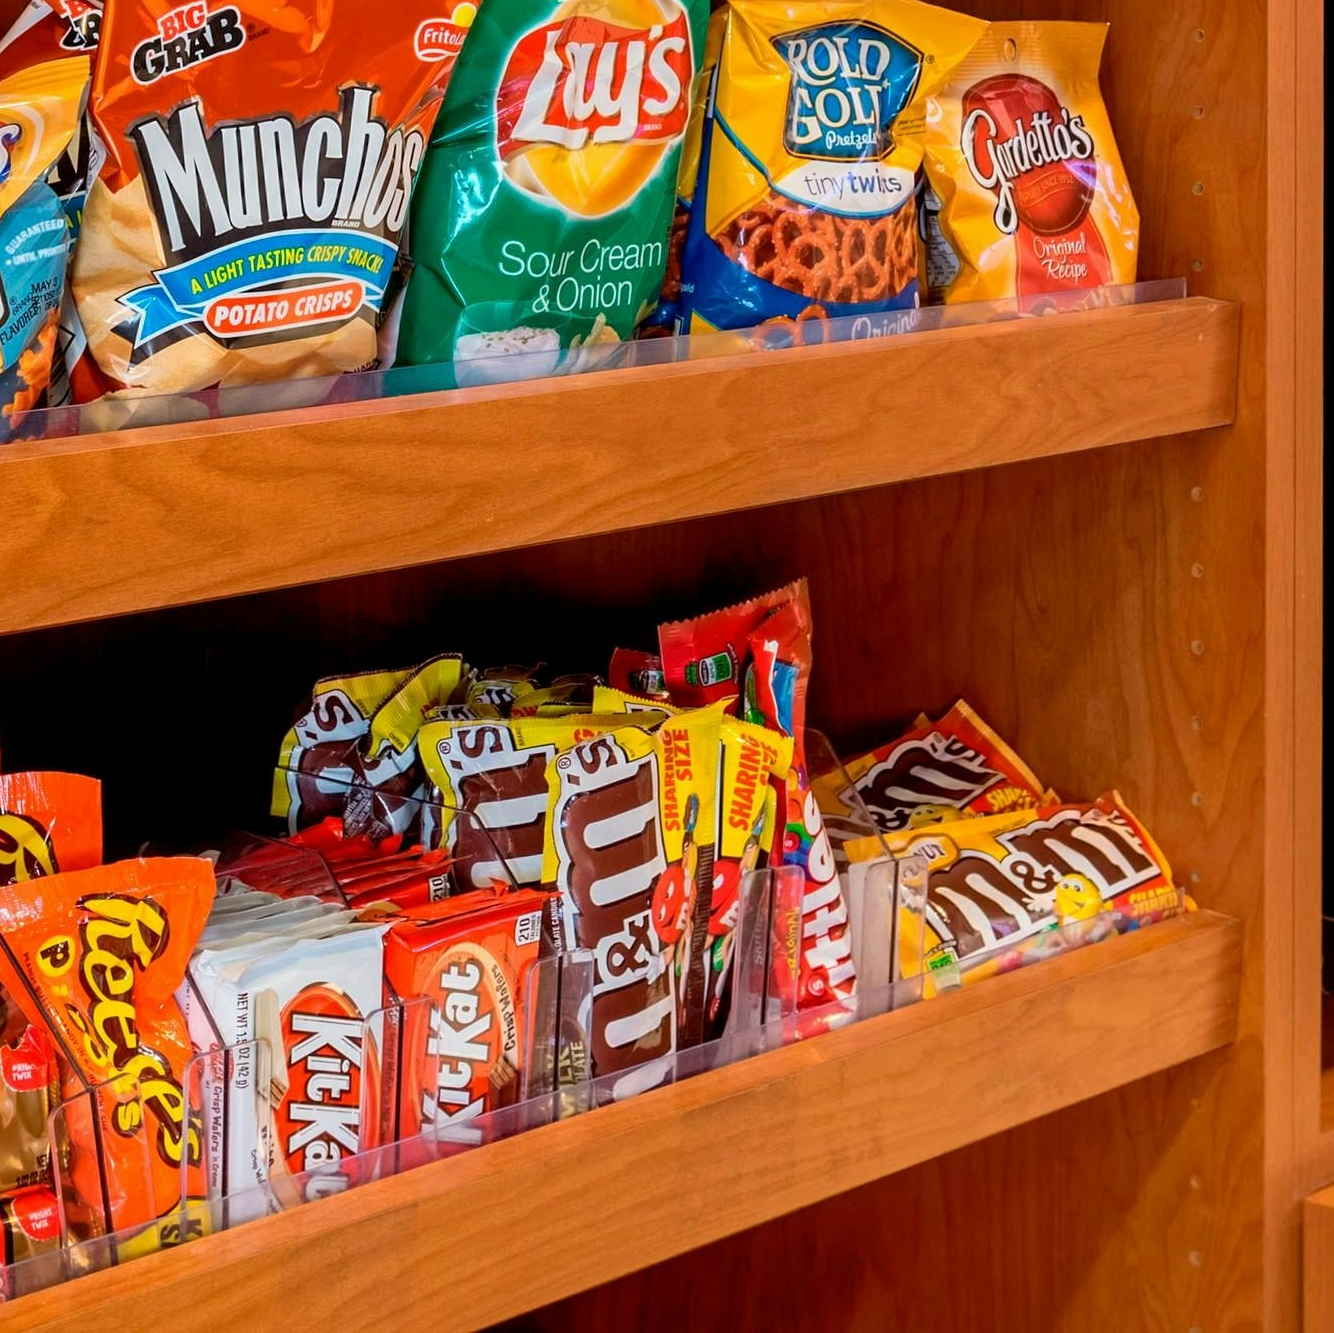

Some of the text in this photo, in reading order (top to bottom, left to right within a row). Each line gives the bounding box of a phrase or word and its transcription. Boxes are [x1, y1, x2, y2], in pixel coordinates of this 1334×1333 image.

[158, 3, 208, 43] BIG
[132, 7, 245, 85] GRAB
[787, 36, 892, 87] ROLD
[509, 24, 687, 151] Lay's
[138, 86, 423, 252] Munchos
[803, 168, 903, 201] tiny twits
[960, 106, 1093, 235] Gardetto's
[5, 217, 65, 255] GUARANTEED
[330, 219, 361, 229] BRAND
[12, 251, 37, 266] UNTIL
[189, 244, 385, 295] A LIGHT TASTING CRISPY SNACK!
[498, 237, 664, 278] Sour Cream
[1033, 235, 1087, 266] Original
[1045, 257, 1088, 284] Recipe
[31, 279, 51, 294] MAY
[531, 275, 634, 315] & Onion
[213, 288, 355, 328] POTATO CRISPS
[663, 728, 691, 833] SHARING SIZE
[727, 732, 764, 832] SHARING
[432, 877, 444, 902] 210
[518, 917, 532, 943] 210
[237, 992, 250, 1061] NET WT OZ
[492, 963, 517, 1052] Crisp Wafers
[421, 958, 492, 1146] KitKat
[11, 1072, 33, 1082] TWIX
[211, 1085, 223, 1153] Crisp Wafers
[287, 1013, 366, 1202] KitKa
[30, 1219, 50, 1232] TWIX
